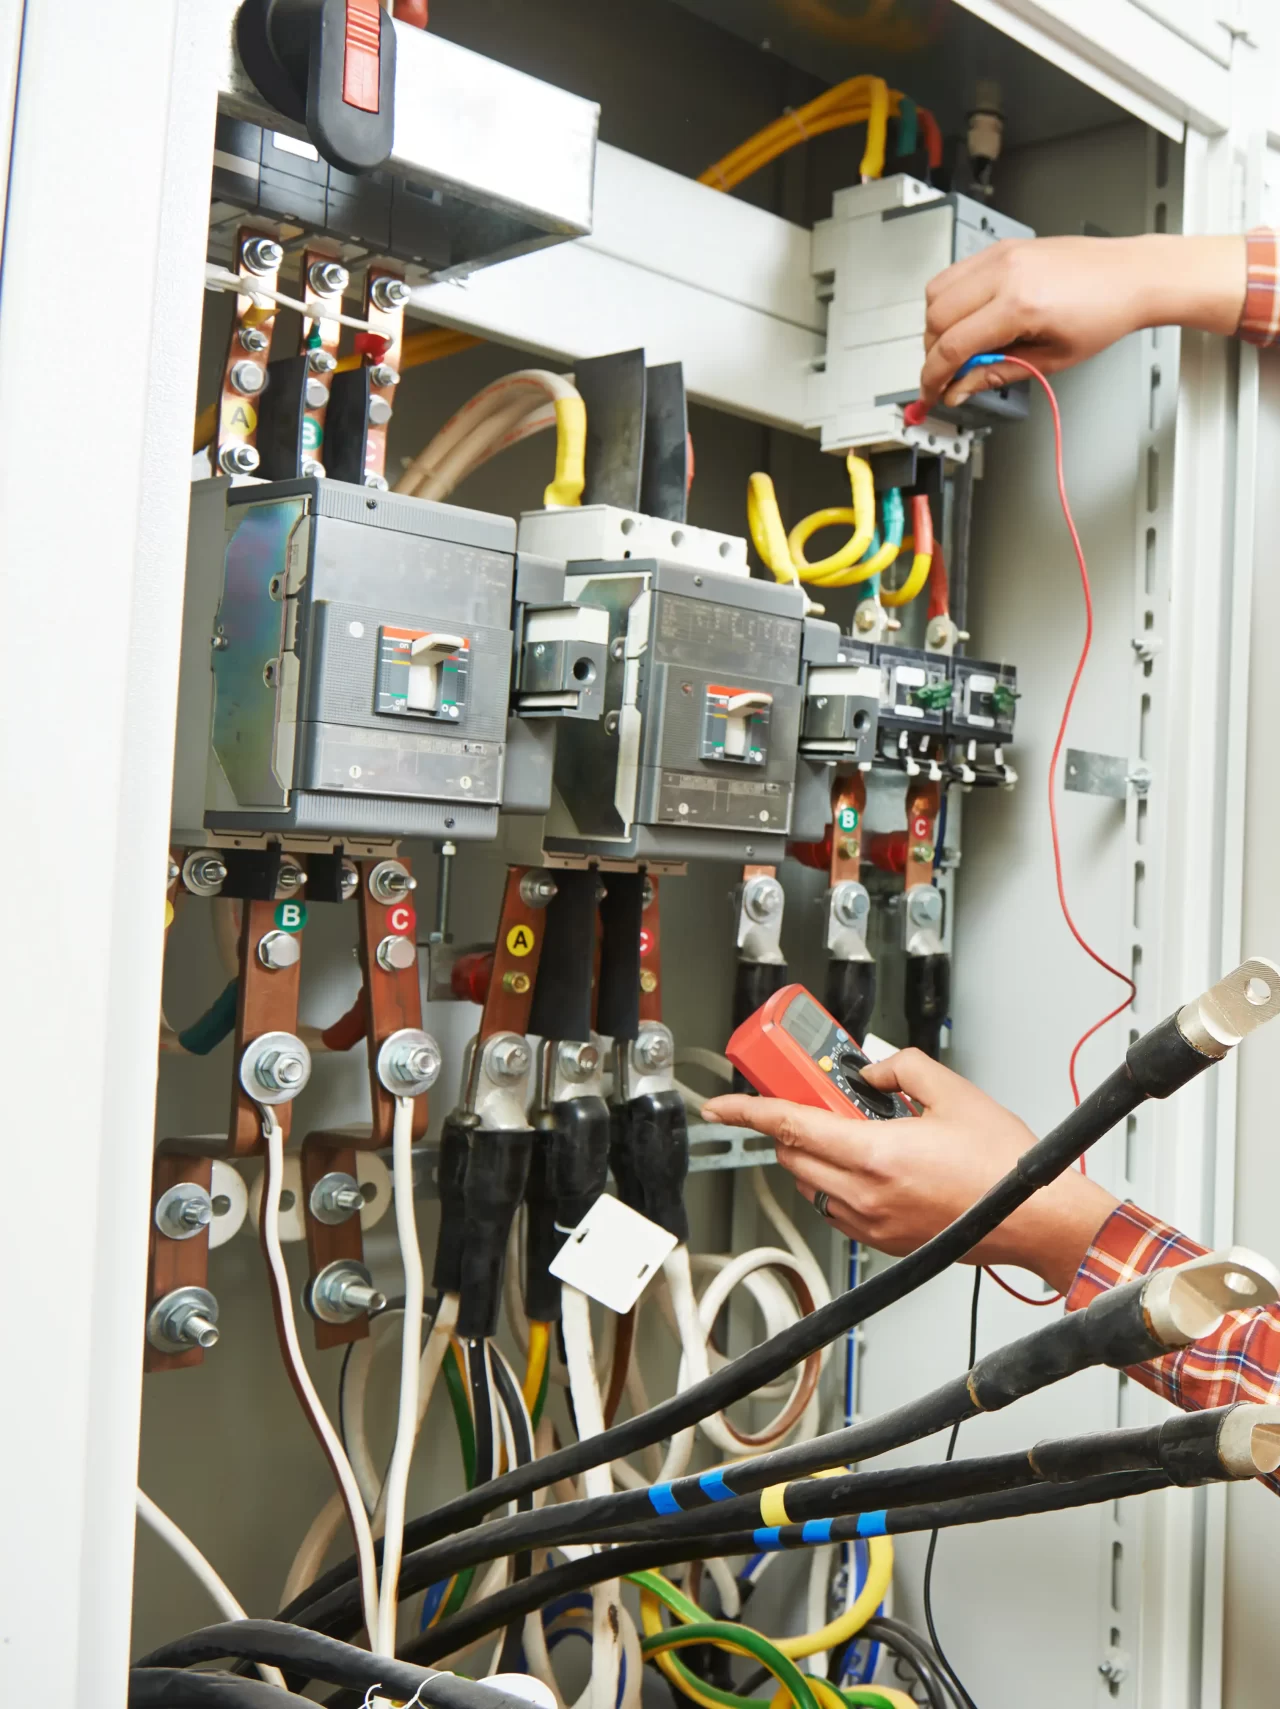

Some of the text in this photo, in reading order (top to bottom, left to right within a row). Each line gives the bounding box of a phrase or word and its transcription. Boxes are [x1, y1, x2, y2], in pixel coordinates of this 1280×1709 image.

[230, 406, 250, 429] A
[842, 810, 855, 829] B
[914, 819, 927, 837] C
[281, 904, 301, 927] B
[391, 908, 409, 931] C
[512, 930, 528, 949] A
